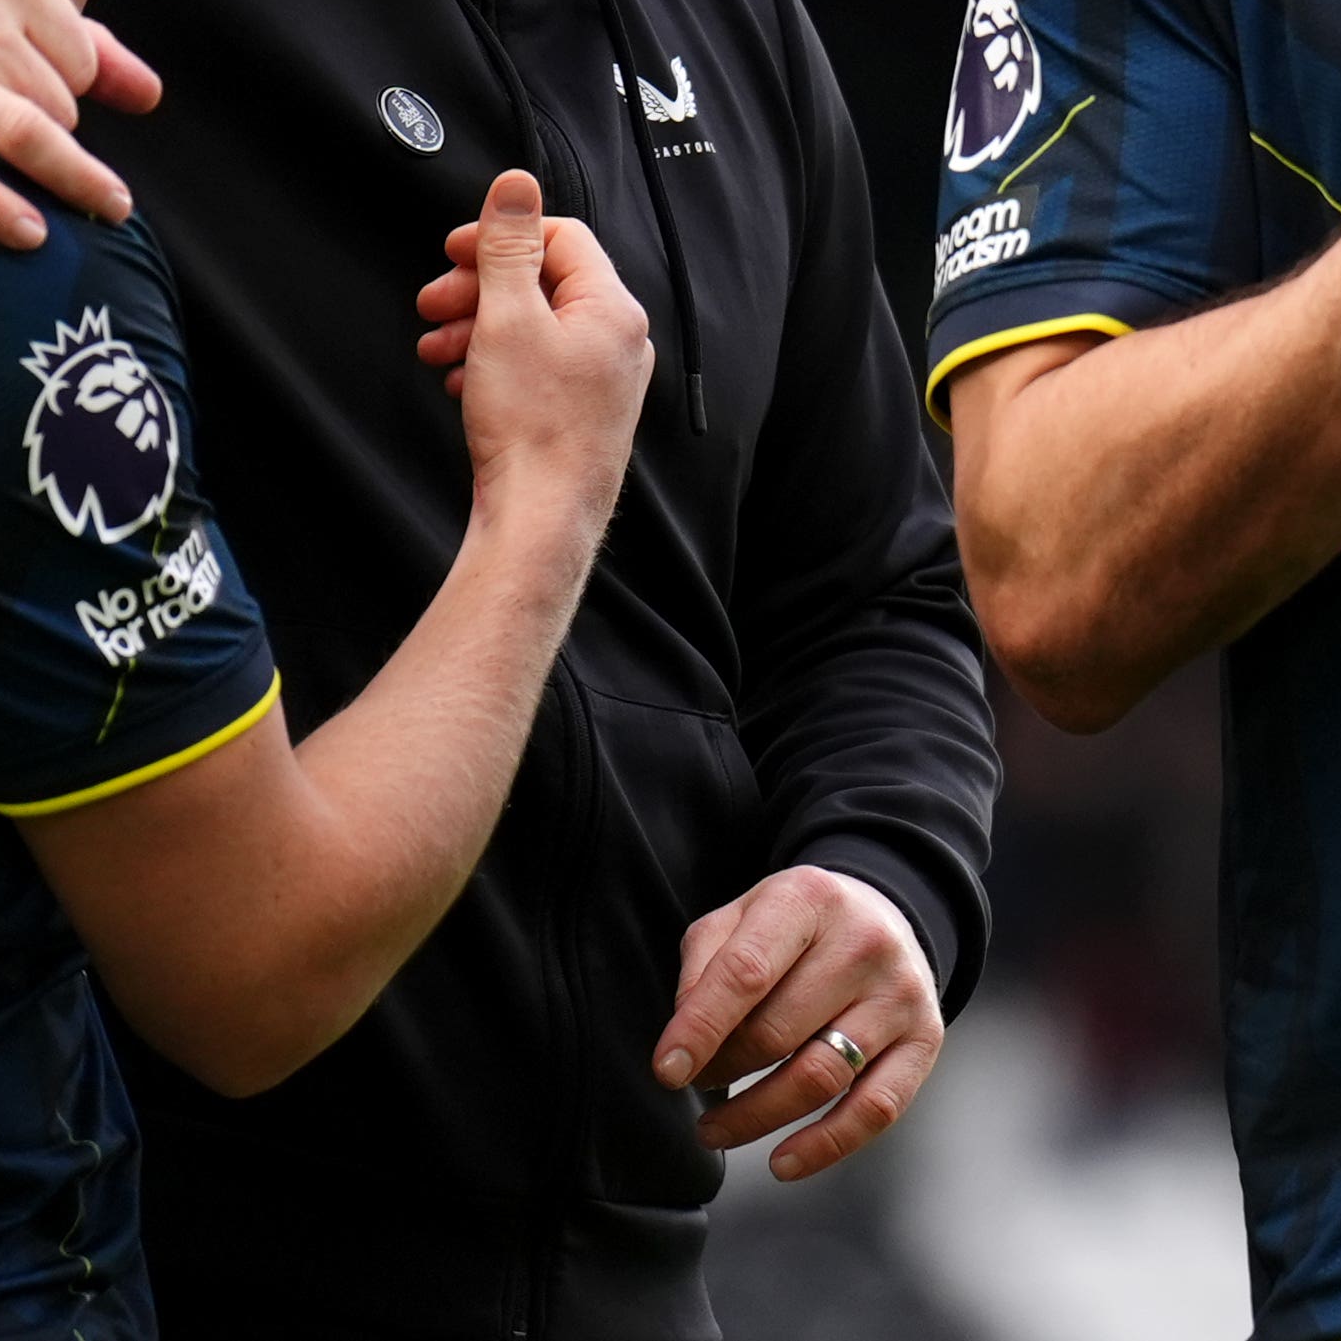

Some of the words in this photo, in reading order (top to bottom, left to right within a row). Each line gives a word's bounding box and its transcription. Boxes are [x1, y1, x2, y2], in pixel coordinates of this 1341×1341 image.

[75, 588, 138, 639] No
[141, 528, 204, 606] room
[93, 615, 147, 667] for
